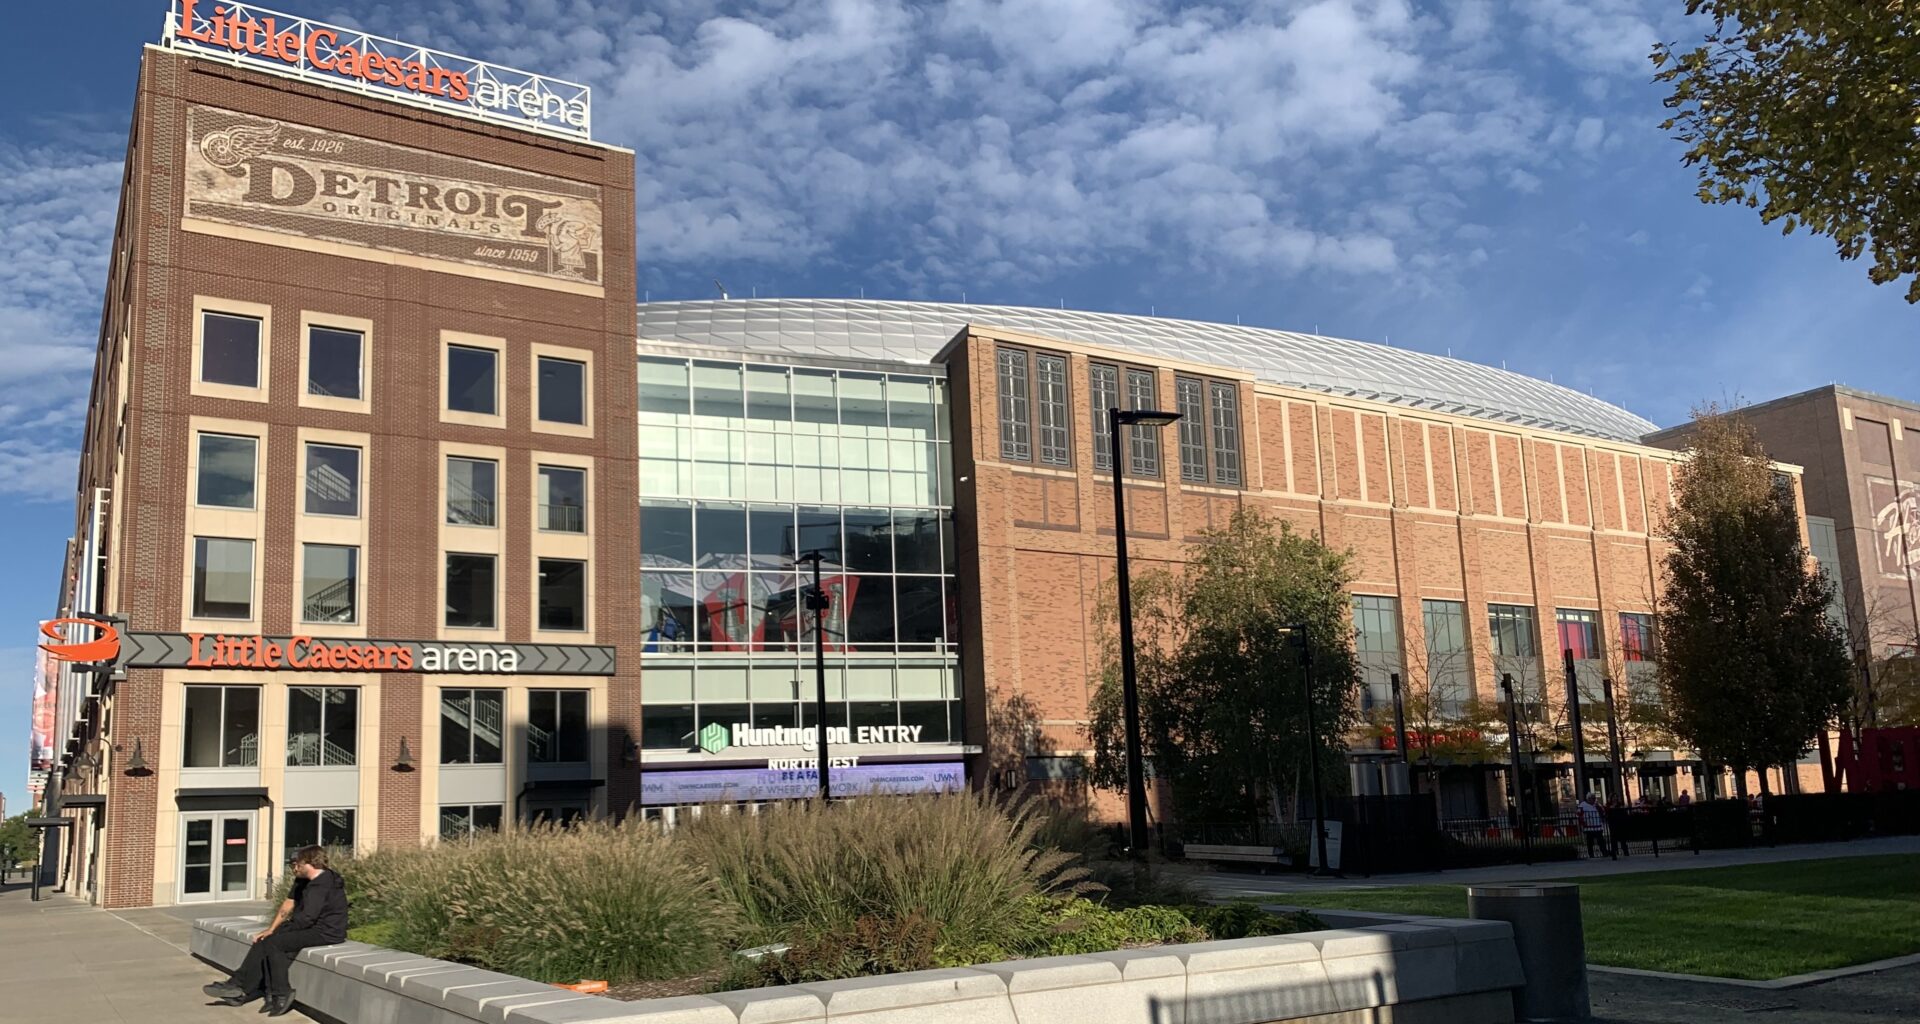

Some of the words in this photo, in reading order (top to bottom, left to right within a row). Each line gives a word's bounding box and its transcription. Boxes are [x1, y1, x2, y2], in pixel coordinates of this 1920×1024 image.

[176, 0, 301, 64] Little
[306, 29, 470, 101] Caesars
[475, 77, 588, 128] arena
[282, 137, 306, 151] est.
[309, 138, 346, 154] 1926
[222, 156, 564, 239] DETROIT
[322, 201, 502, 234] ORIGINALS
[473, 245, 506, 260] since
[507, 247, 539, 263] 1959
[186, 632, 283, 670] Little
[287, 635, 414, 671] Caesars
[421, 646, 518, 673] arena
[857, 725, 923, 744] ENTRY
[766, 785, 801, 794] WHERE
[803, 784, 819, 793] YO
[830, 782, 858, 793] WORK
